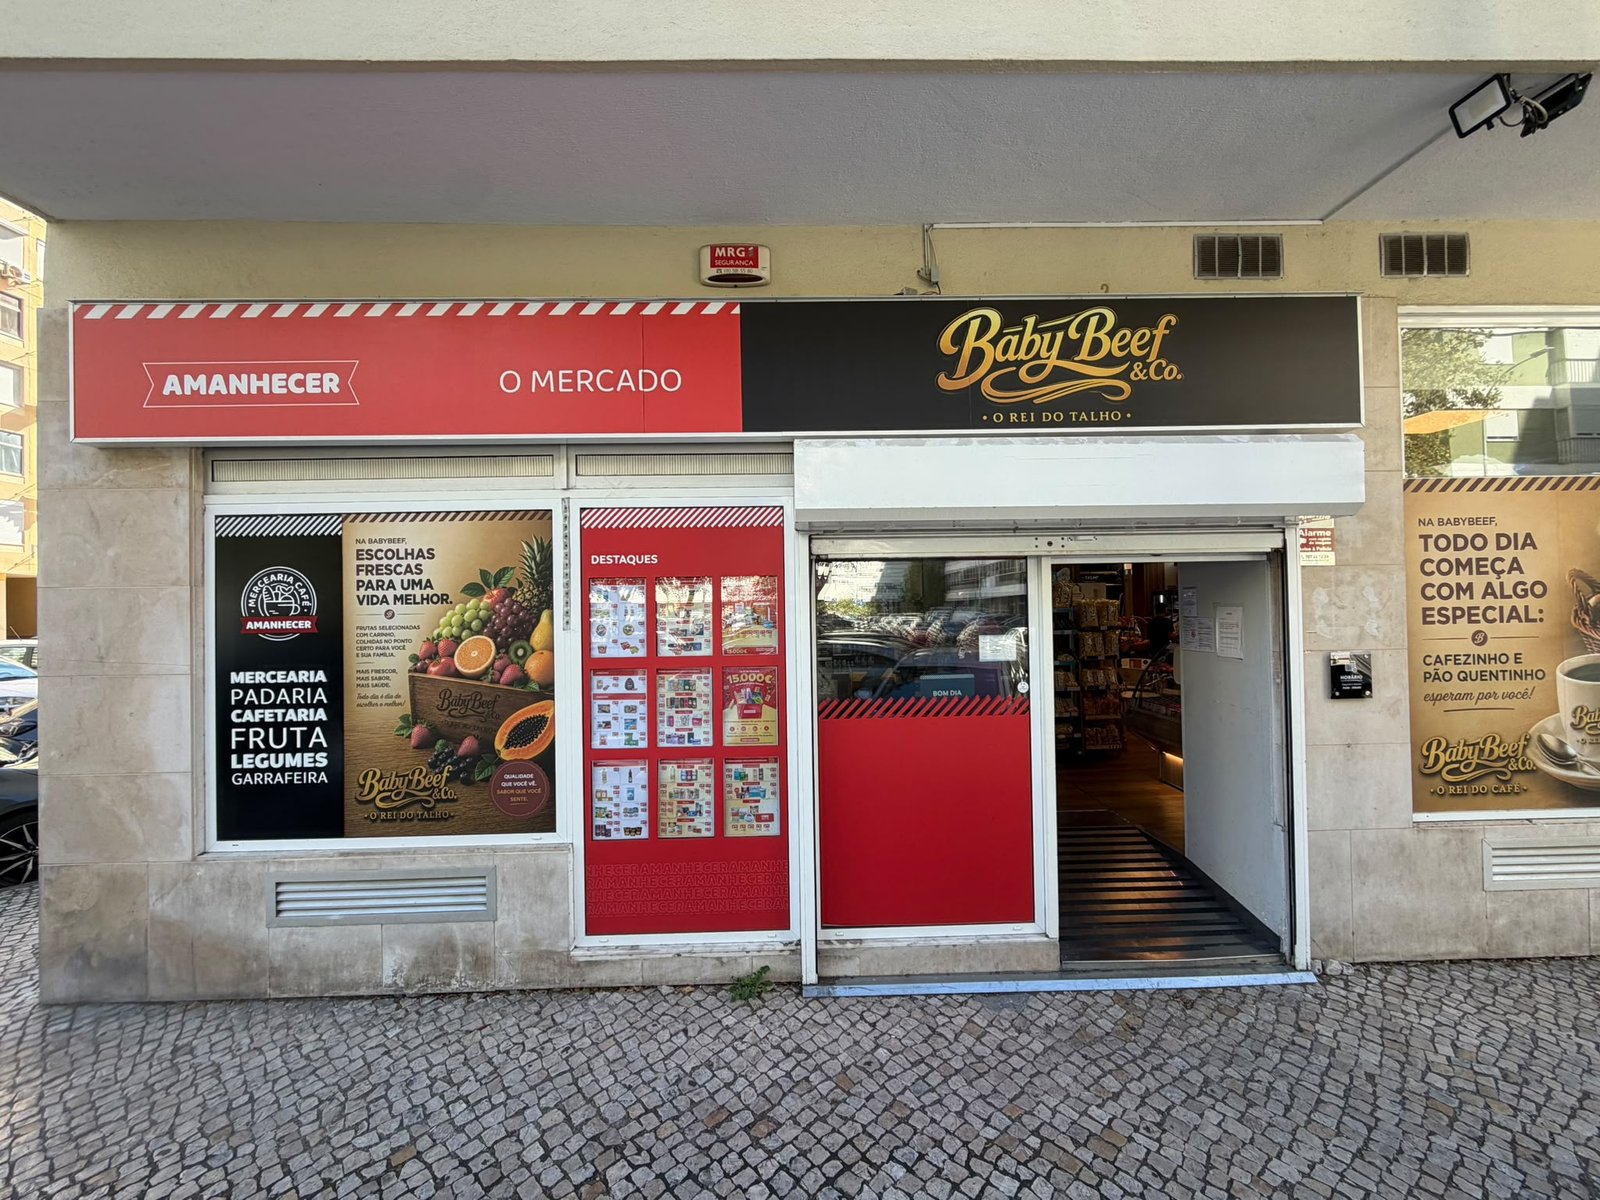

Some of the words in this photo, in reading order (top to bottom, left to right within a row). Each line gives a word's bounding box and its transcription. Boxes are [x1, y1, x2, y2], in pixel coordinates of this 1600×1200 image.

[715, 247, 745, 257] MRG
[937, 307, 1066, 391] Baby
[1067, 307, 1177, 362] Beef
[1129, 359, 1182, 381] &Co.
[162, 372, 340, 396] AMANHECER
[499, 370, 521, 394] O
[530, 368, 682, 394] MERCADO
[993, 412, 1004, 423] O
[1010, 412, 1035, 423] REI
[1042, 412, 1064, 422] DO
[1069, 410, 1122, 422] TALHO
[1418, 517, 1434, 527] NA
[1437, 516, 1498, 527] BABYBEEF,
[368, 537, 407, 545] BABYBEEF,
[1418, 533, 1488, 552] TODO
[1495, 532, 1538, 551] DIA
[356, 548, 435, 560] ESCOLHAS
[590, 554, 658, 565] DESTAQUES
[356, 563, 423, 576] FRESCAS
[1419, 556, 1525, 580] COMEÇA
[248, 573, 294, 607] MERCEARIA
[295, 582, 312, 607] CAFÉ
[356, 579, 396, 591] PARA
[400, 578, 434, 591] UMA
[1420, 581, 1474, 601] COM
[1481, 580, 1548, 600] ALGO
[356, 594, 391, 606] VIDA
[393, 593, 453, 605] MELHOR.
[1421, 604, 1544, 626] ESPECIAL:
[246, 620, 312, 630] AMANHECER
[1422, 652, 1509, 666] CAFEZINHO
[1514, 652, 1523, 665] E
[230, 670, 328, 684] MERCEARIA
[1423, 667, 1453, 683] PÃO
[1457, 668, 1546, 683] QUENTINHO
[231, 687, 328, 705] PADARIA
[1423, 690, 1475, 706] esperam
[1475, 690, 1500, 706] por
[1501, 686, 1536, 701] você!
[230, 707, 328, 722] CAFETARIA
[231, 726, 328, 750] FRUTA
[230, 752, 328, 769] LEGUMES
[1420, 736, 1482, 774] Baby
[1480, 733, 1530, 762] Beef
[1508, 758, 1537, 771] &Co.
[231, 771, 328, 785] GARRAFEIRA
[357, 767, 408, 800] Baby
[408, 765, 453, 791] Beef
[432, 787, 457, 800] &Co.
[1436, 786, 1445, 795] O
[1449, 785, 1468, 794] REI
[1471, 785, 1487, 794] DO
[1491, 783, 1521, 793] CAFÉ
[370, 811, 377, 820] O
[380, 811, 397, 820] REI
[401, 811, 414, 819] DO
[416, 810, 449, 819] TALHO
